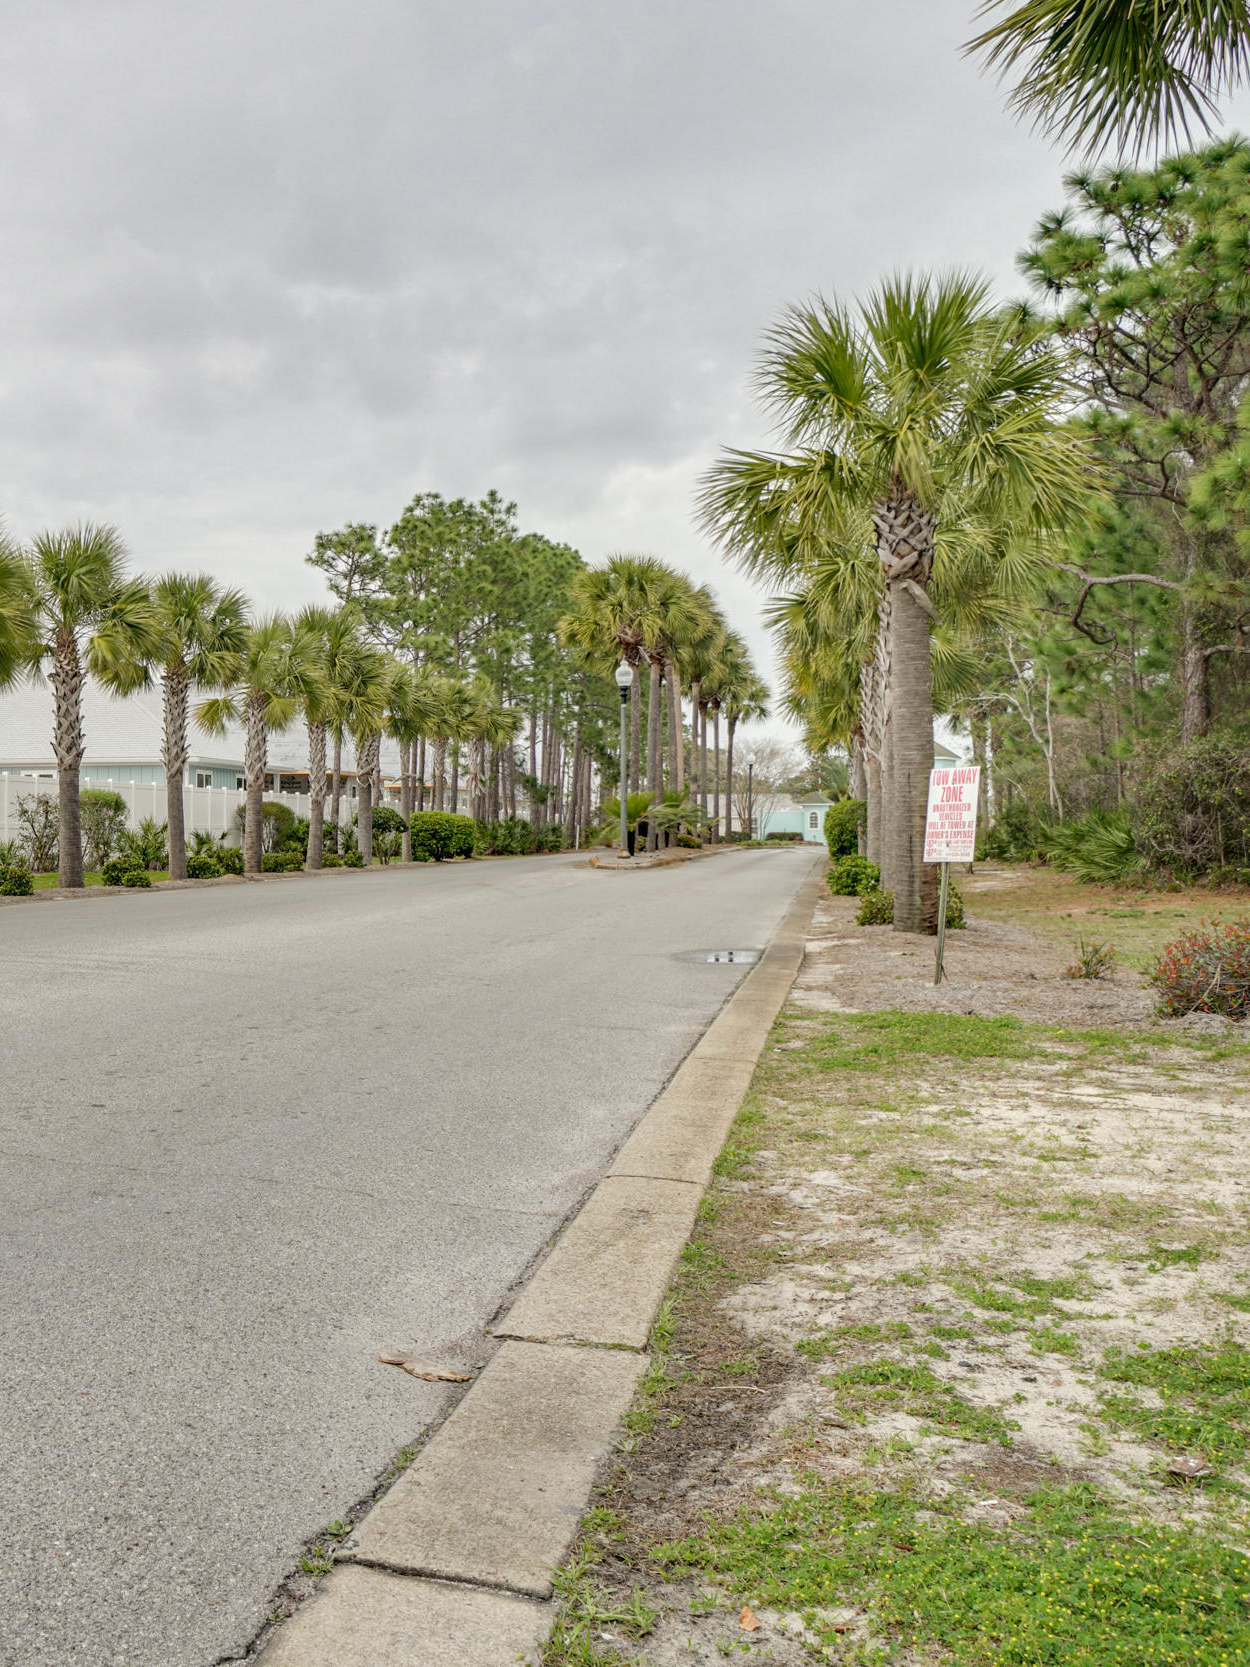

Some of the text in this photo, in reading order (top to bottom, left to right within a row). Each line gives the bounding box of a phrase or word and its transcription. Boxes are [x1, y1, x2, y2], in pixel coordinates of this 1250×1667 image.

[933, 768, 978, 786] TOW AWAY
[941, 786, 964, 802] ZONE
[950, 830, 974, 838] EXPENSE
